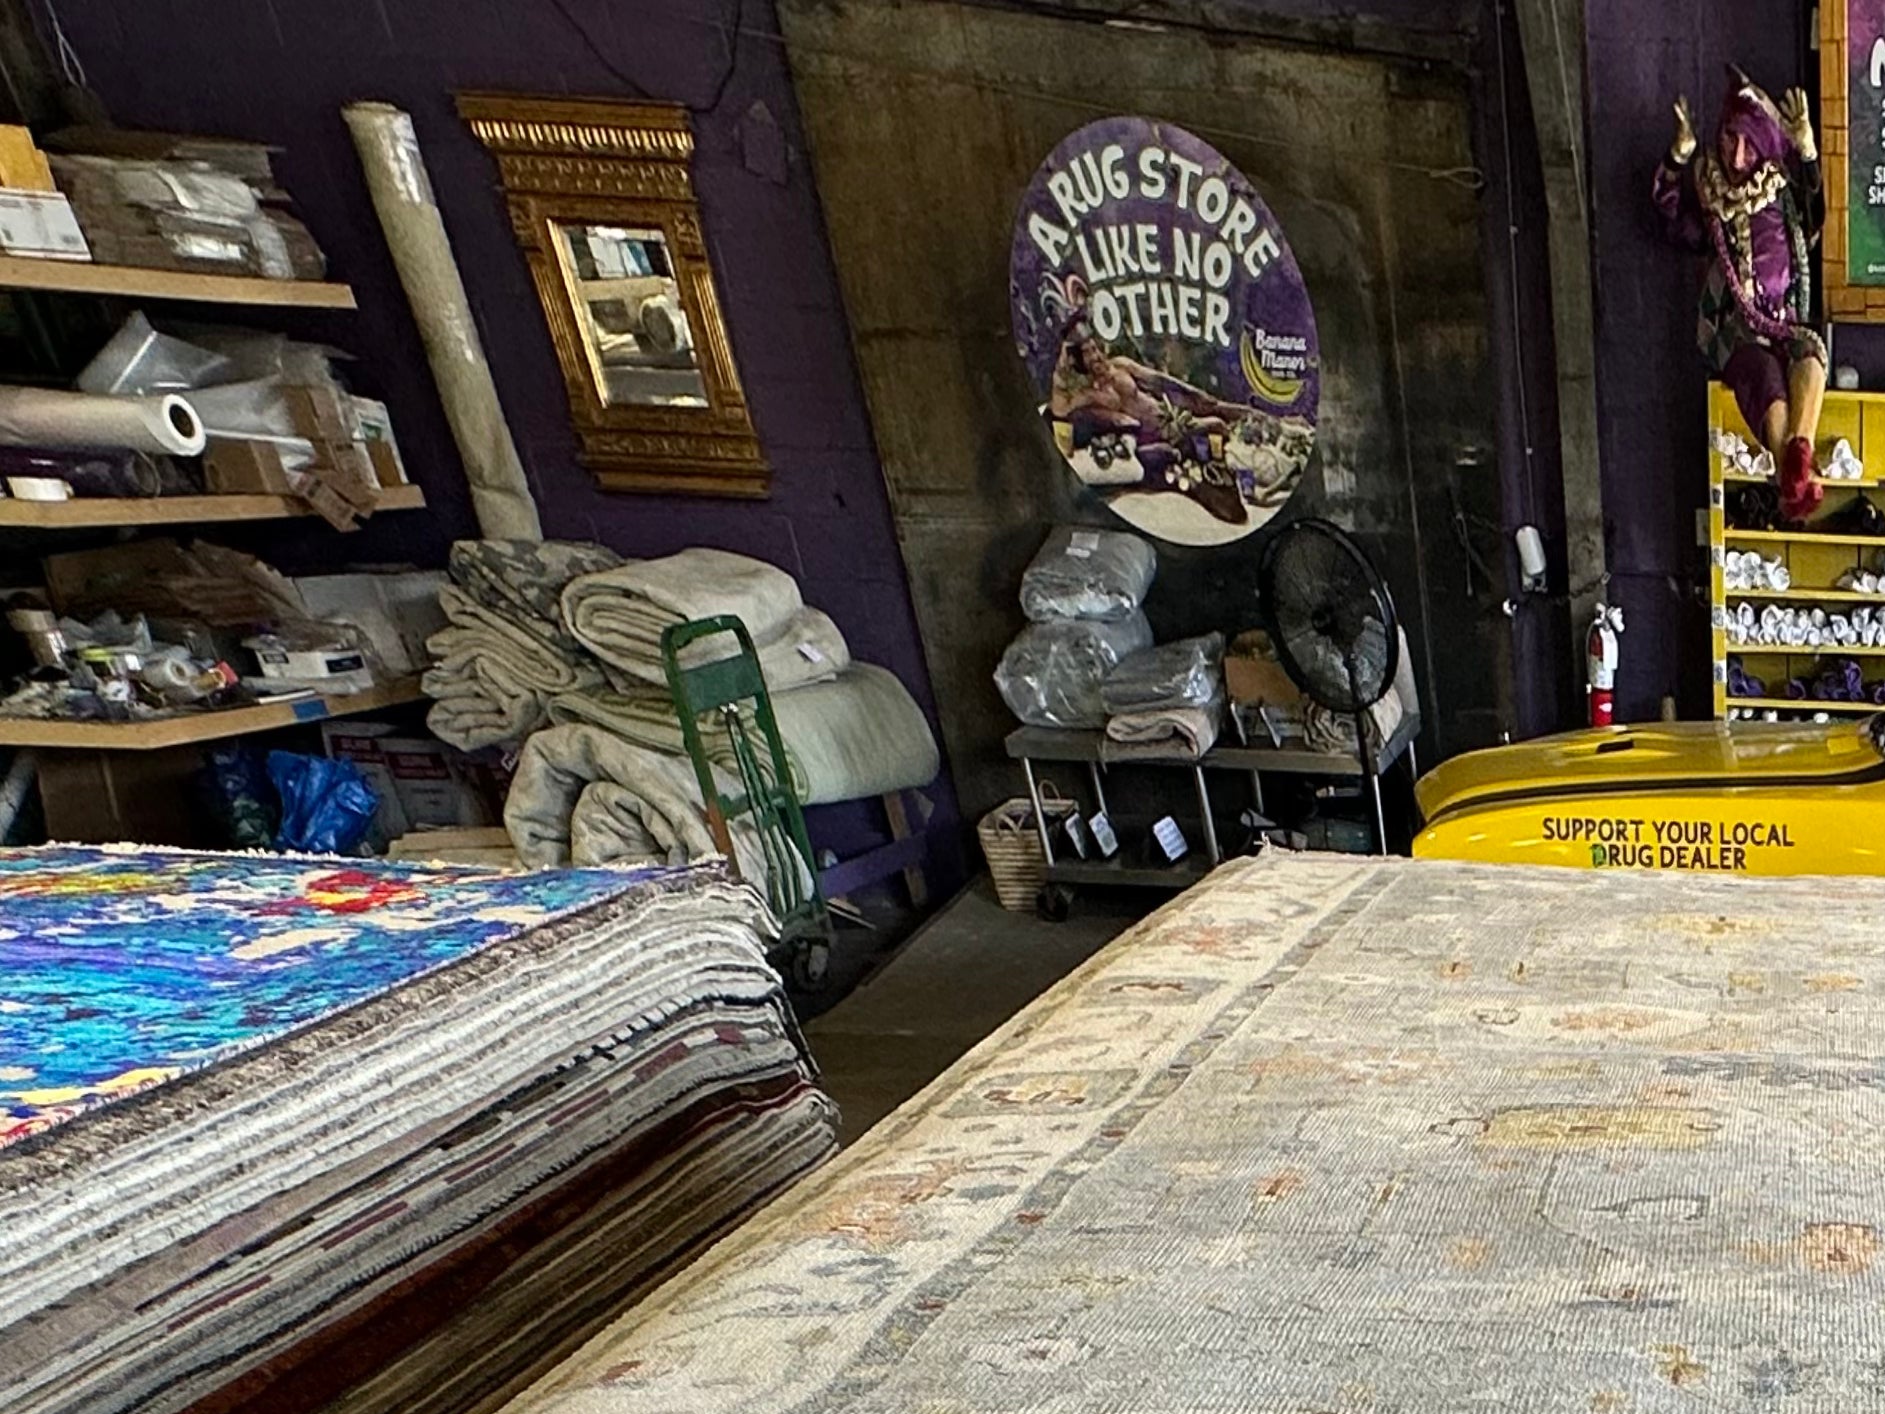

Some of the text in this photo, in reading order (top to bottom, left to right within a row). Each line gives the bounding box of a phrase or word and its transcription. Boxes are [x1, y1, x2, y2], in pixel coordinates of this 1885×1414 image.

[1028, 144, 1280, 278] A RUG STORE
[1077, 224, 1232, 288] LIKE NO
[1091, 282, 1231, 347] OTHER
[1255, 328, 1307, 351] Banana
[1261, 350, 1305, 371] Manor
[1543, 817, 1795, 847] SUPPORT YOUR LOCAL
[1590, 843, 1747, 870] DRUG DEALER
